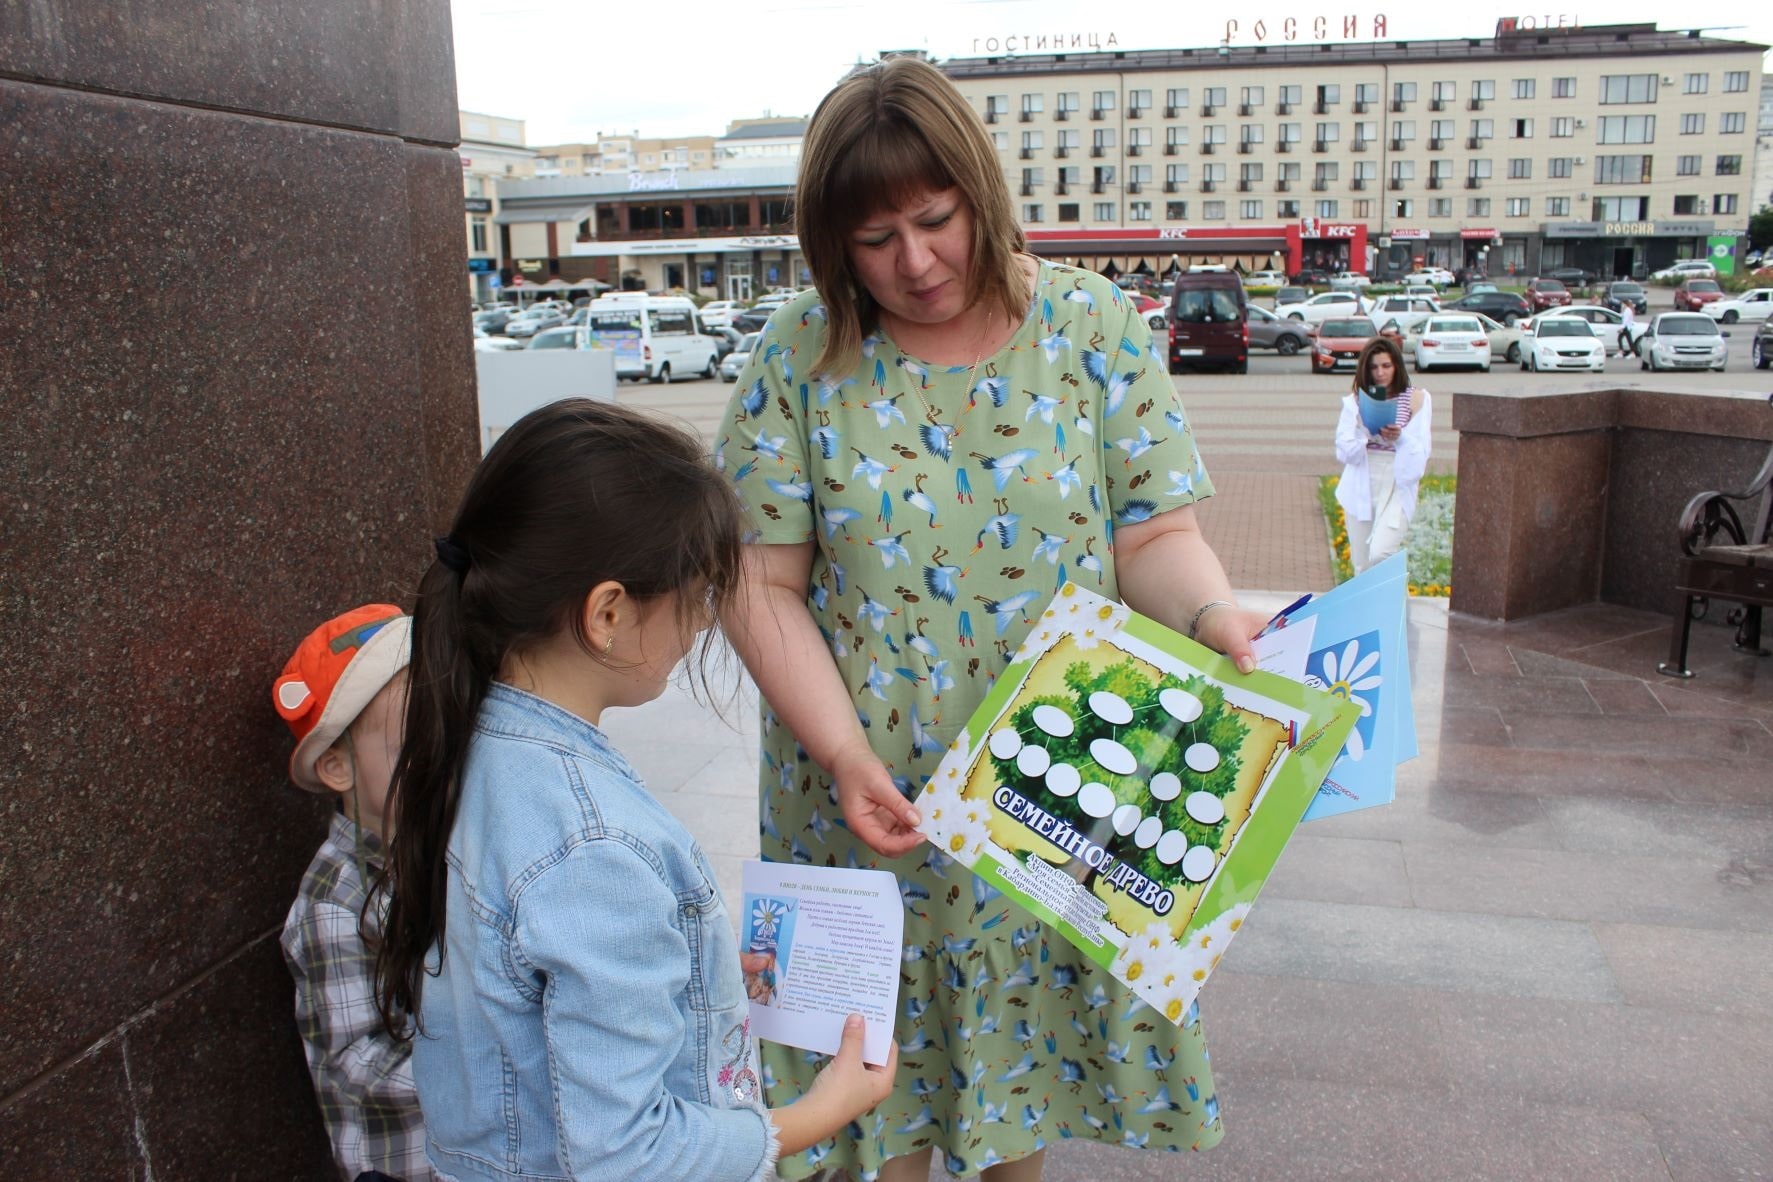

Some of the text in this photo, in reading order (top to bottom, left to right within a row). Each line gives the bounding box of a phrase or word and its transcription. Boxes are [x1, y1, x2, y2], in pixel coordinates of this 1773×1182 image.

[1226, 13, 1387, 43] РОССИЯ
[973, 32, 1118, 53] ГОСТИНИЦА
[1160, 229, 1187, 239] KFC
[1327, 225, 1356, 237] KFC
[1605, 223, 1655, 235] РОССИЯ
[994, 787, 1173, 914] СЕМЕЙНОЕ ДРЕВО
